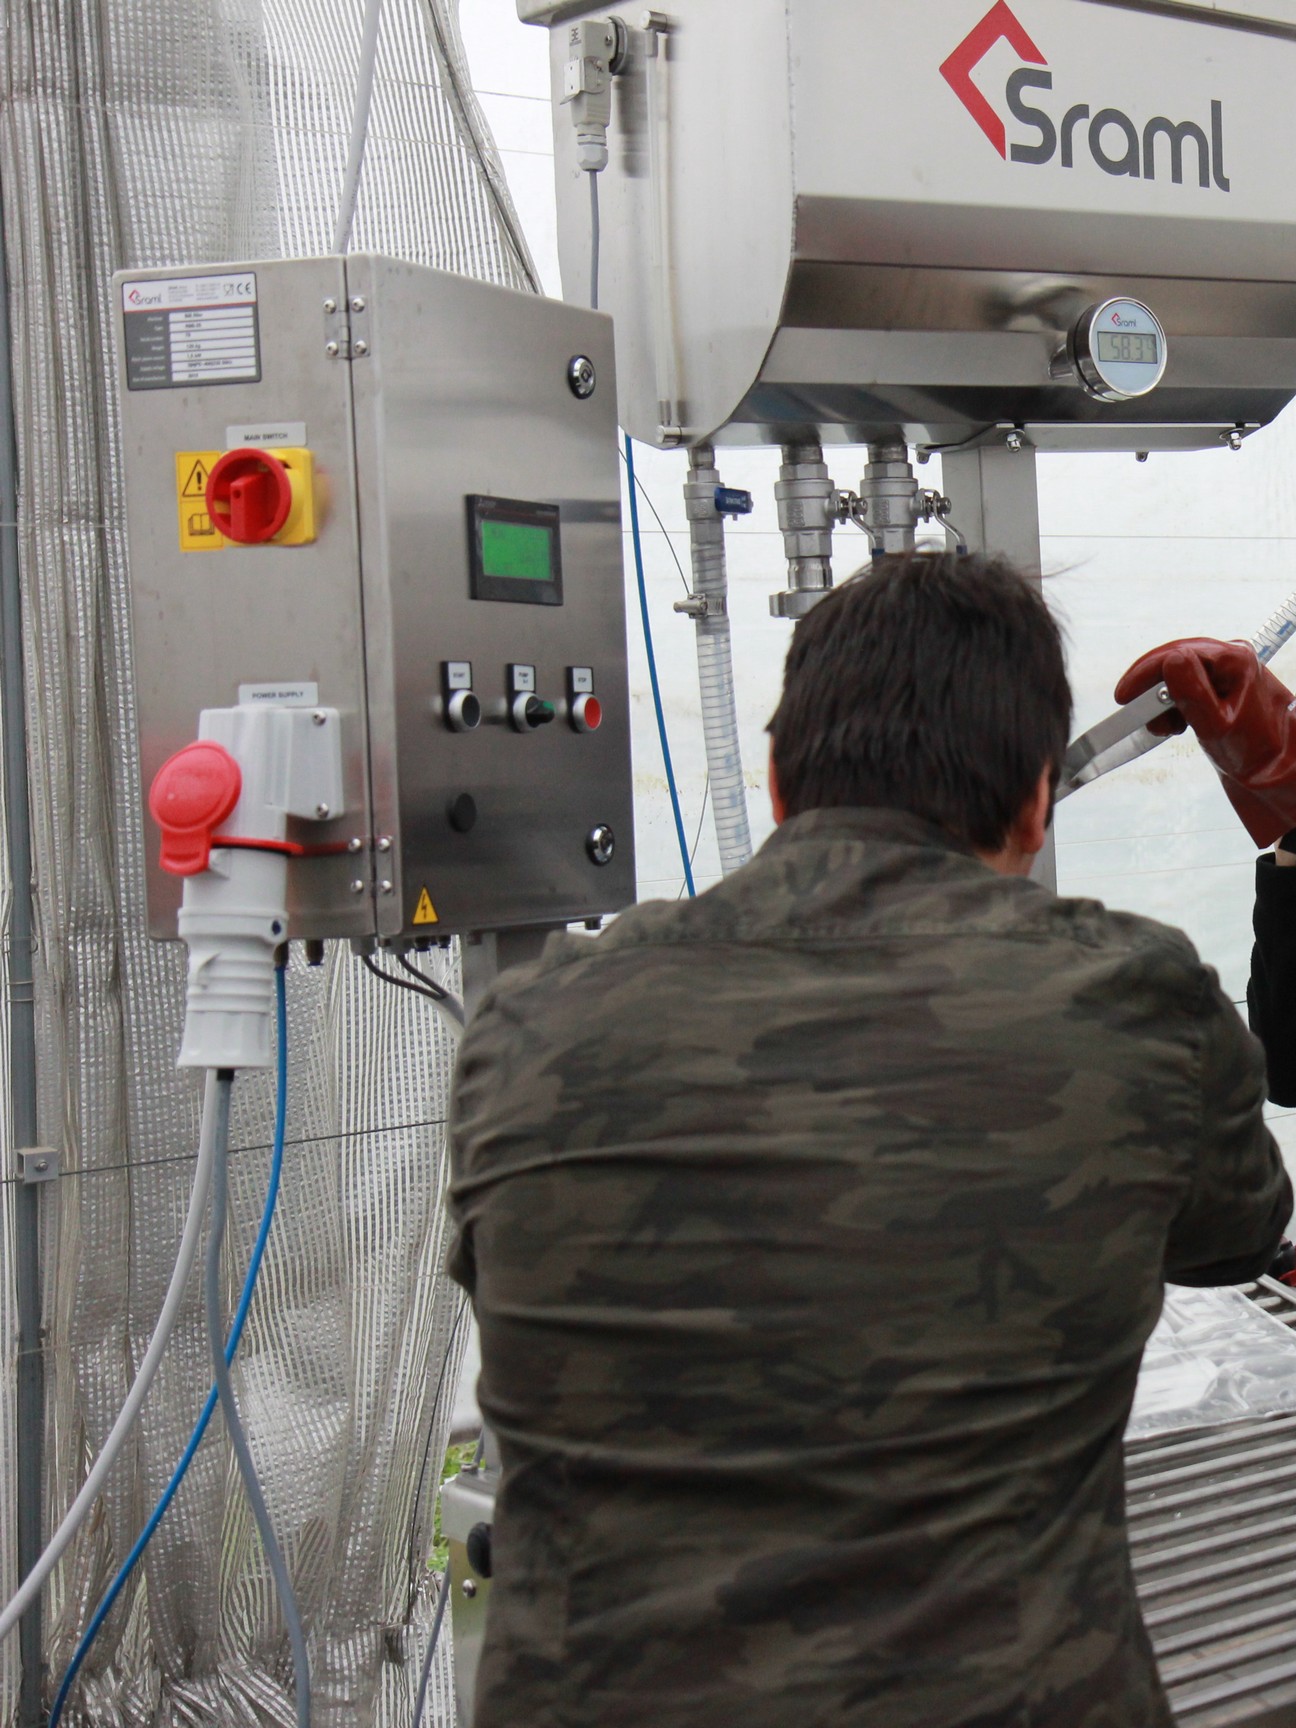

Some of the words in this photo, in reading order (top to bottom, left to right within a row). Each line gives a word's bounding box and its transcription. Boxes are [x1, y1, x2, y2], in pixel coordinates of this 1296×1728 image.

[1005, 67, 1230, 193] Sraml
[135, 293, 162, 305] Sraml
[1117, 317, 1137, 327] Sraml
